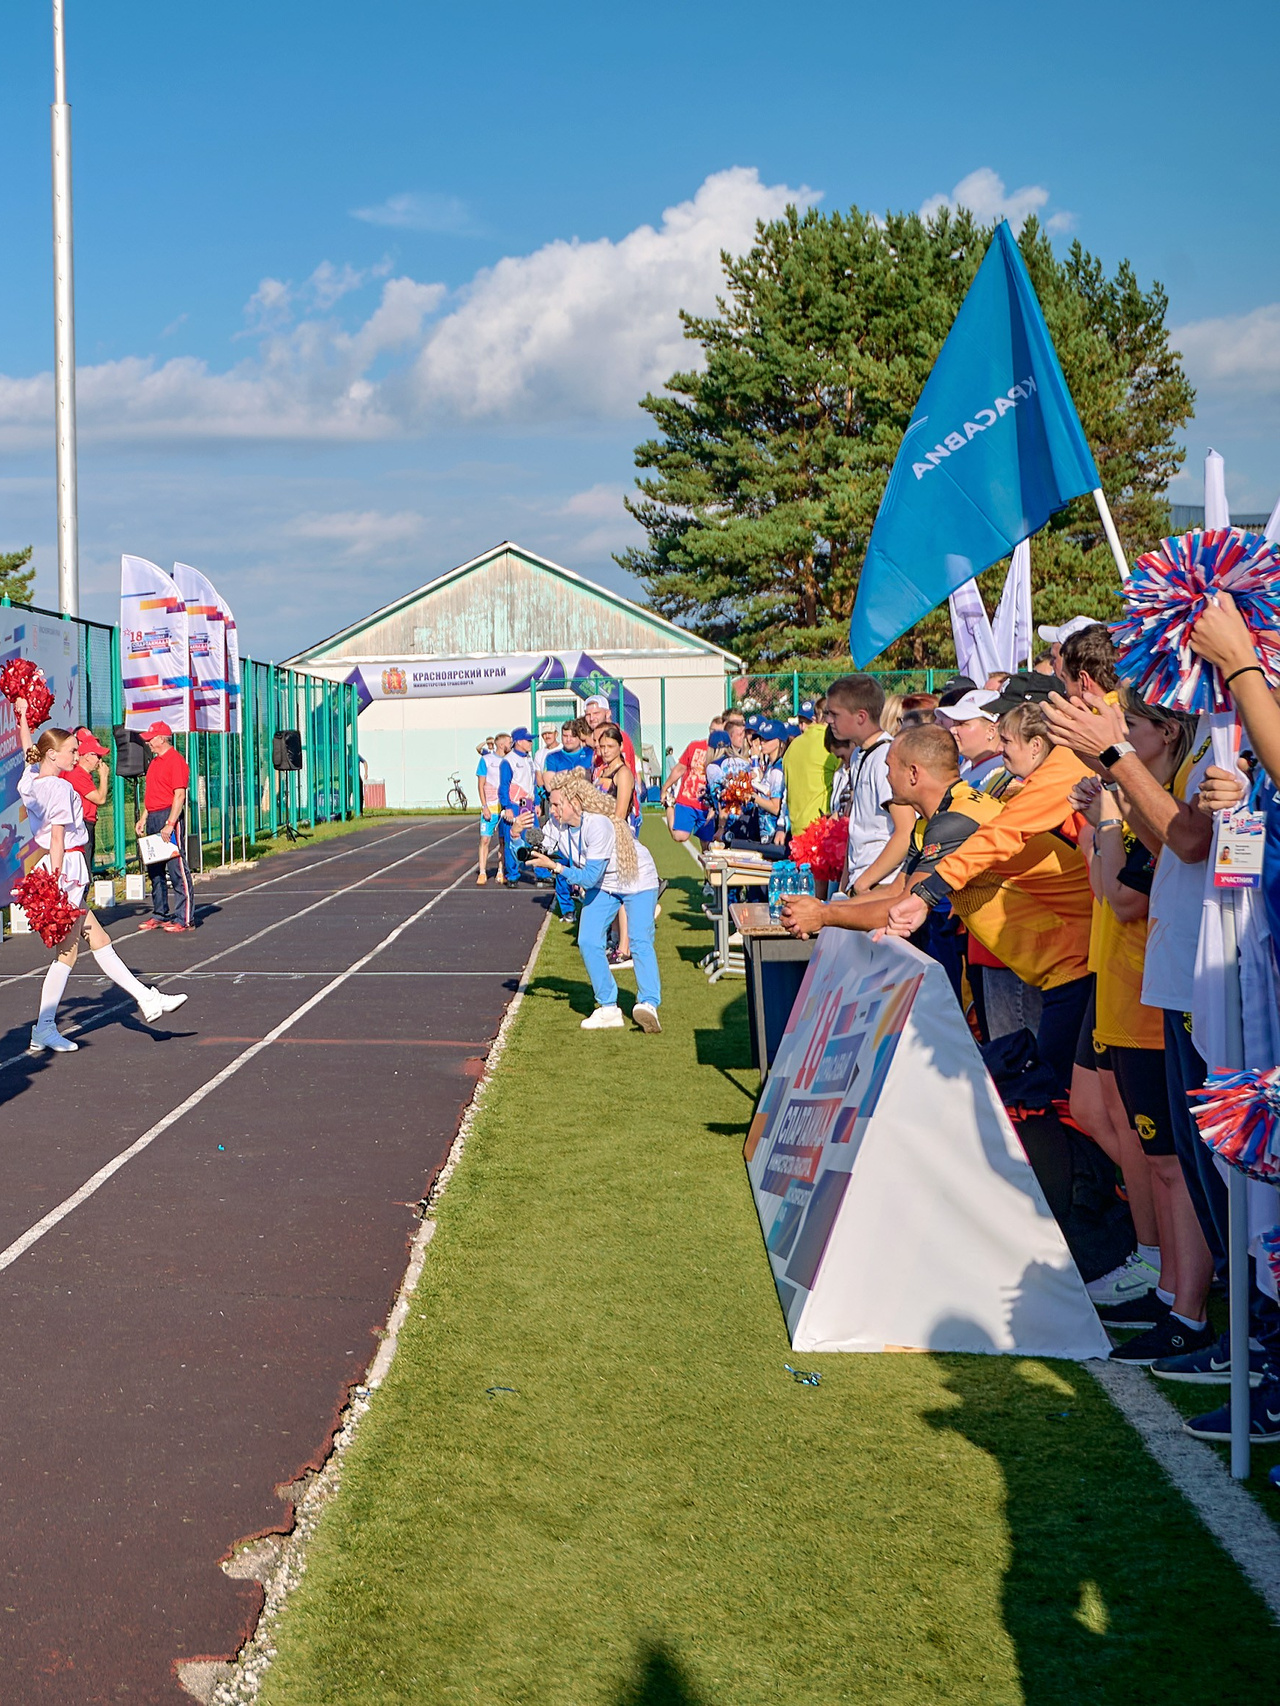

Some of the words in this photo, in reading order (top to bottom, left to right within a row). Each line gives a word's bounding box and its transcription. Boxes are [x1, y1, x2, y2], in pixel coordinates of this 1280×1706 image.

[130, 630, 143, 642] 18
[412, 667, 481, 682] КРАСНОЯРСКИЙ
[484, 665, 507, 678] КРАЙ
[1220, 876, 1254, 884] УЧАСТНИК
[793, 986, 843, 1090] 18
